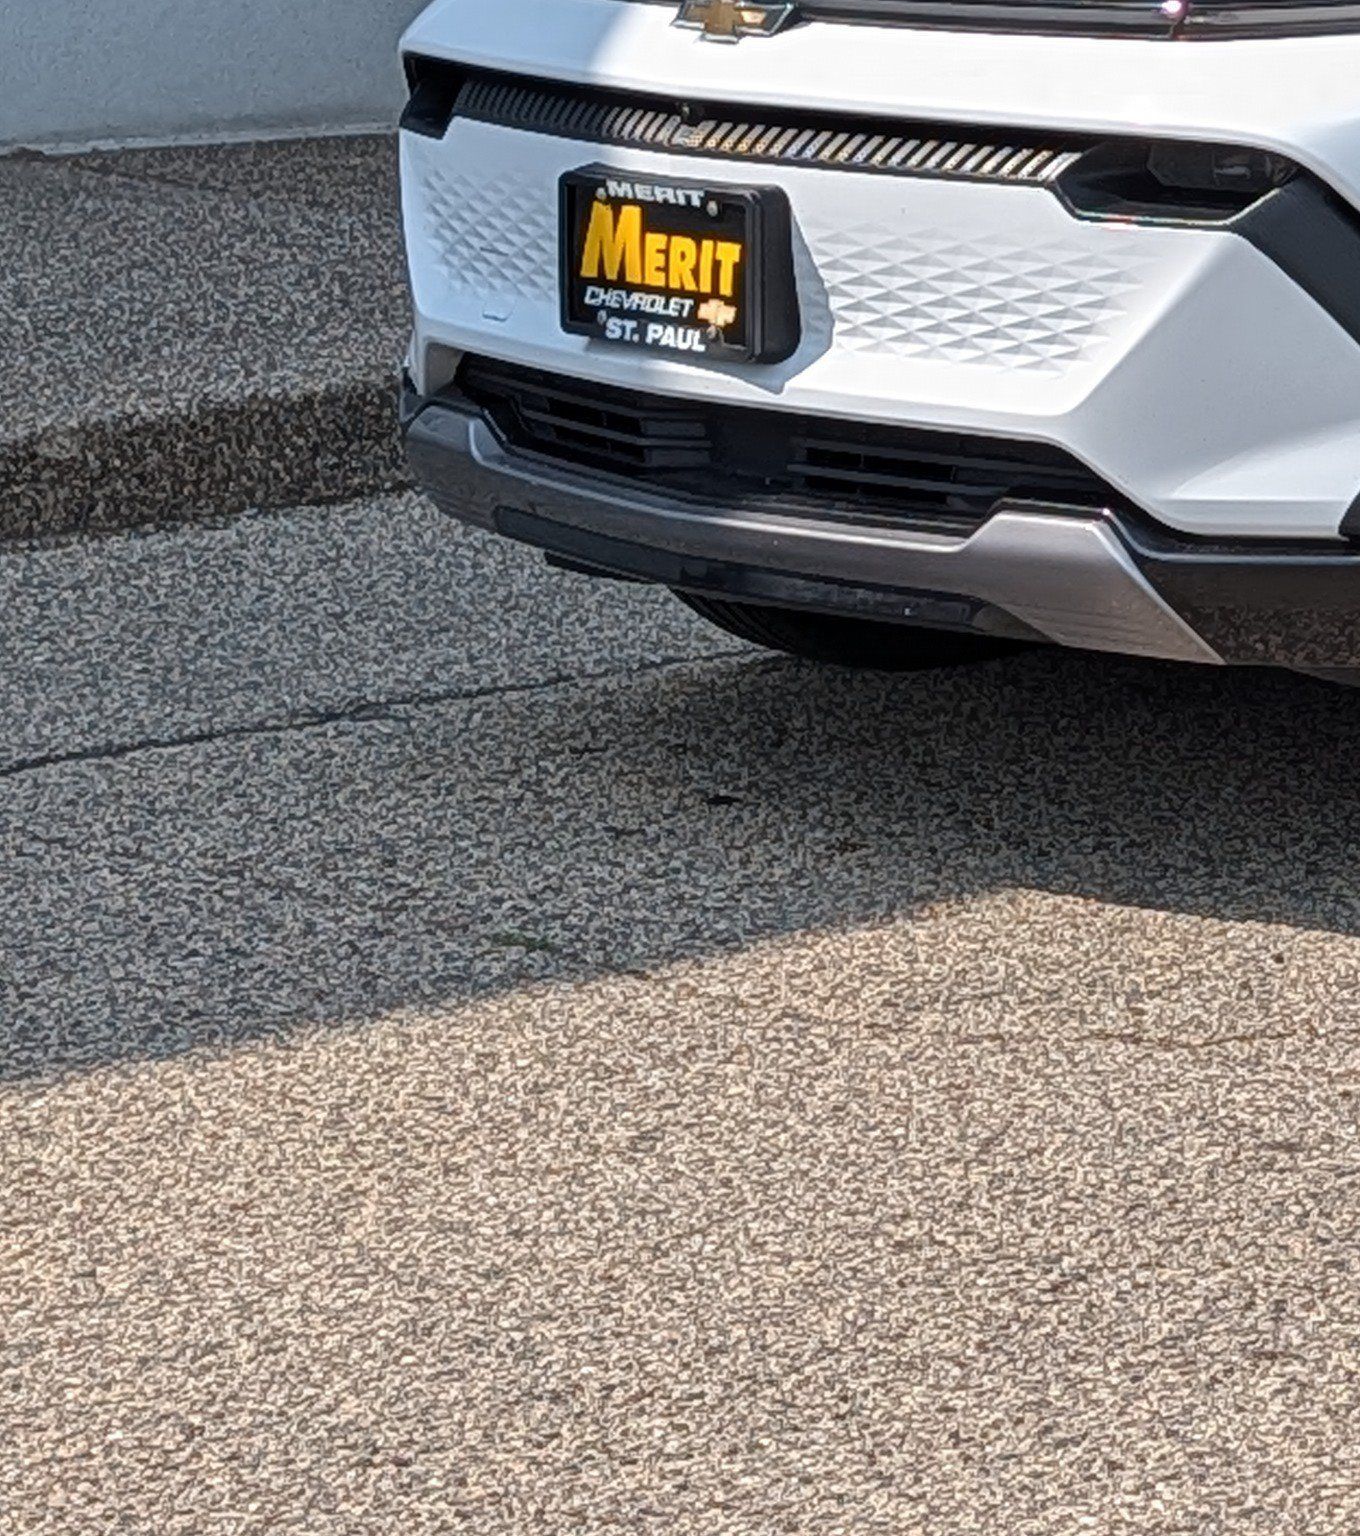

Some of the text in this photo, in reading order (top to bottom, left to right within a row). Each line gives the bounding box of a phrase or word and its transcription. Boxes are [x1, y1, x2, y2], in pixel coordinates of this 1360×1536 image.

[605, 181, 705, 208] MERIT
[580, 201, 742, 297] MERIT
[584, 285, 695, 318] CHEVROLET
[605, 318, 706, 352] ST. PAUL
